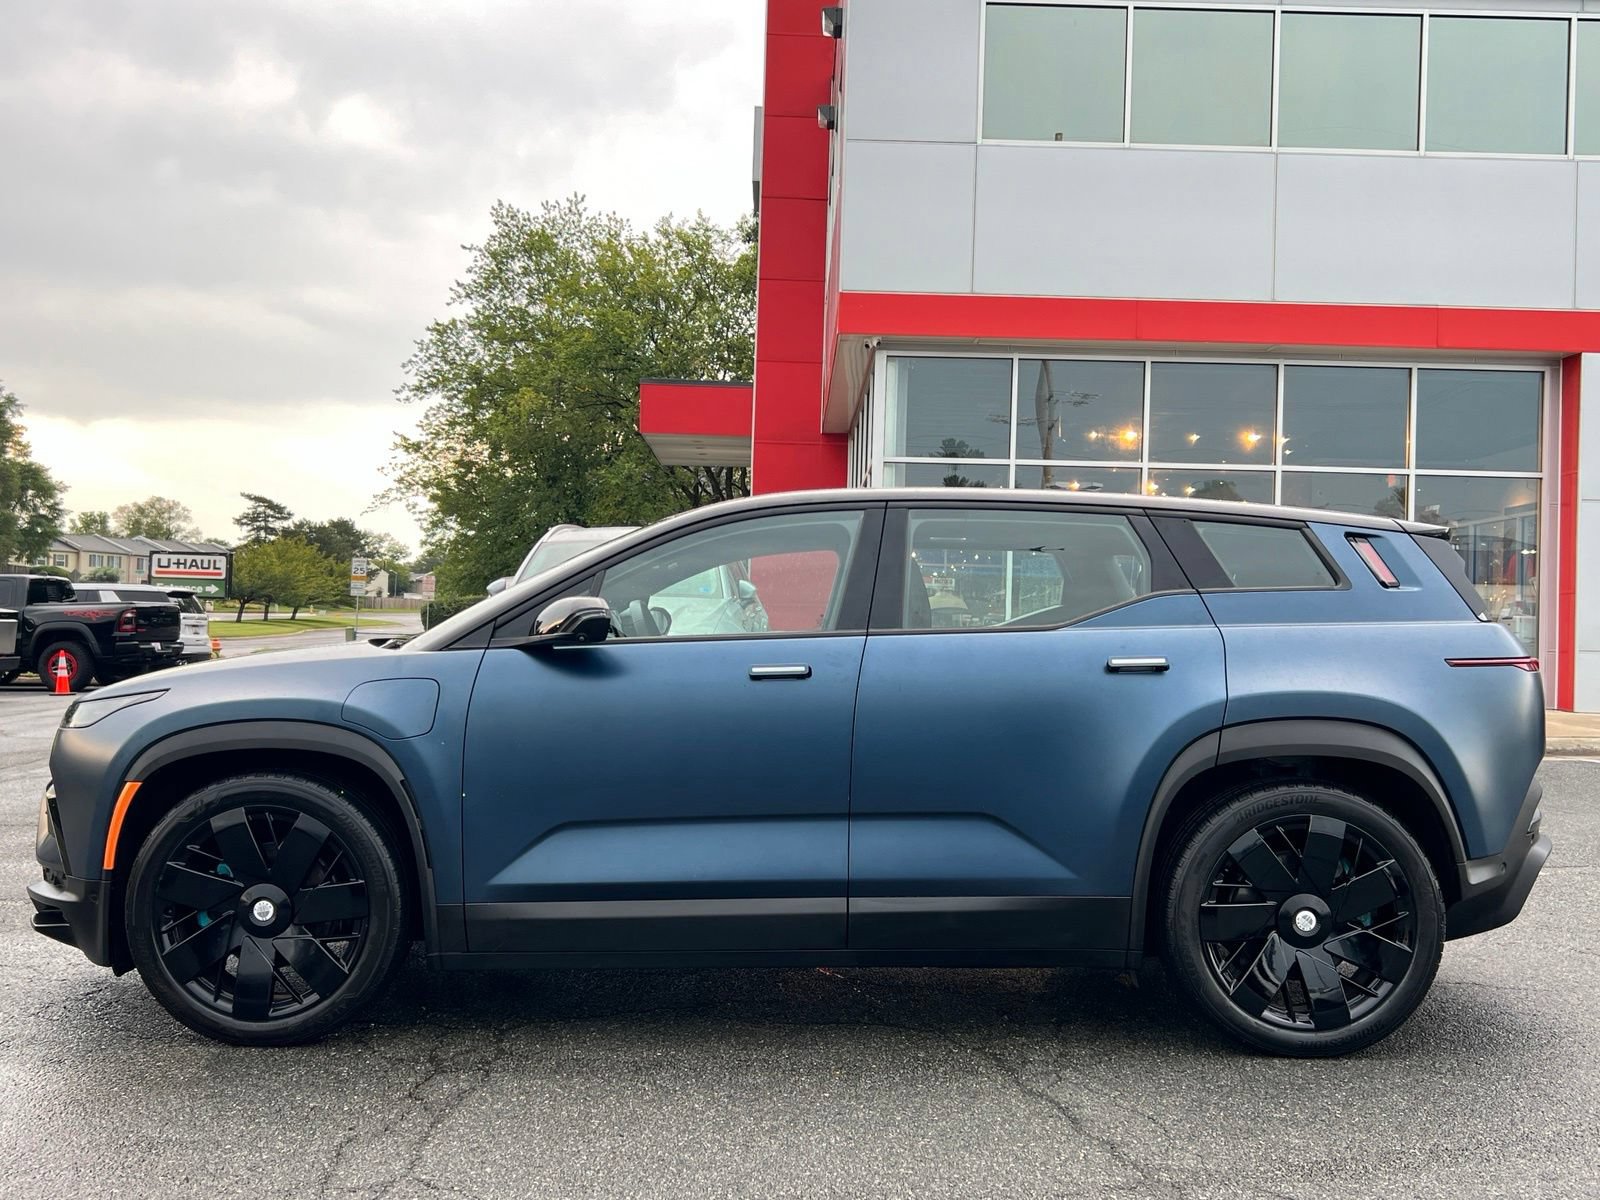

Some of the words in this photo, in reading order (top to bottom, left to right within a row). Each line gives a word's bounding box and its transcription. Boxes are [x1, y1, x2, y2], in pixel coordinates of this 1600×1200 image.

[157, 558, 221, 570] U-HAUL
[353, 567, 366, 575] 25
[1233, 794, 1319, 822] BRIDGESTONE
